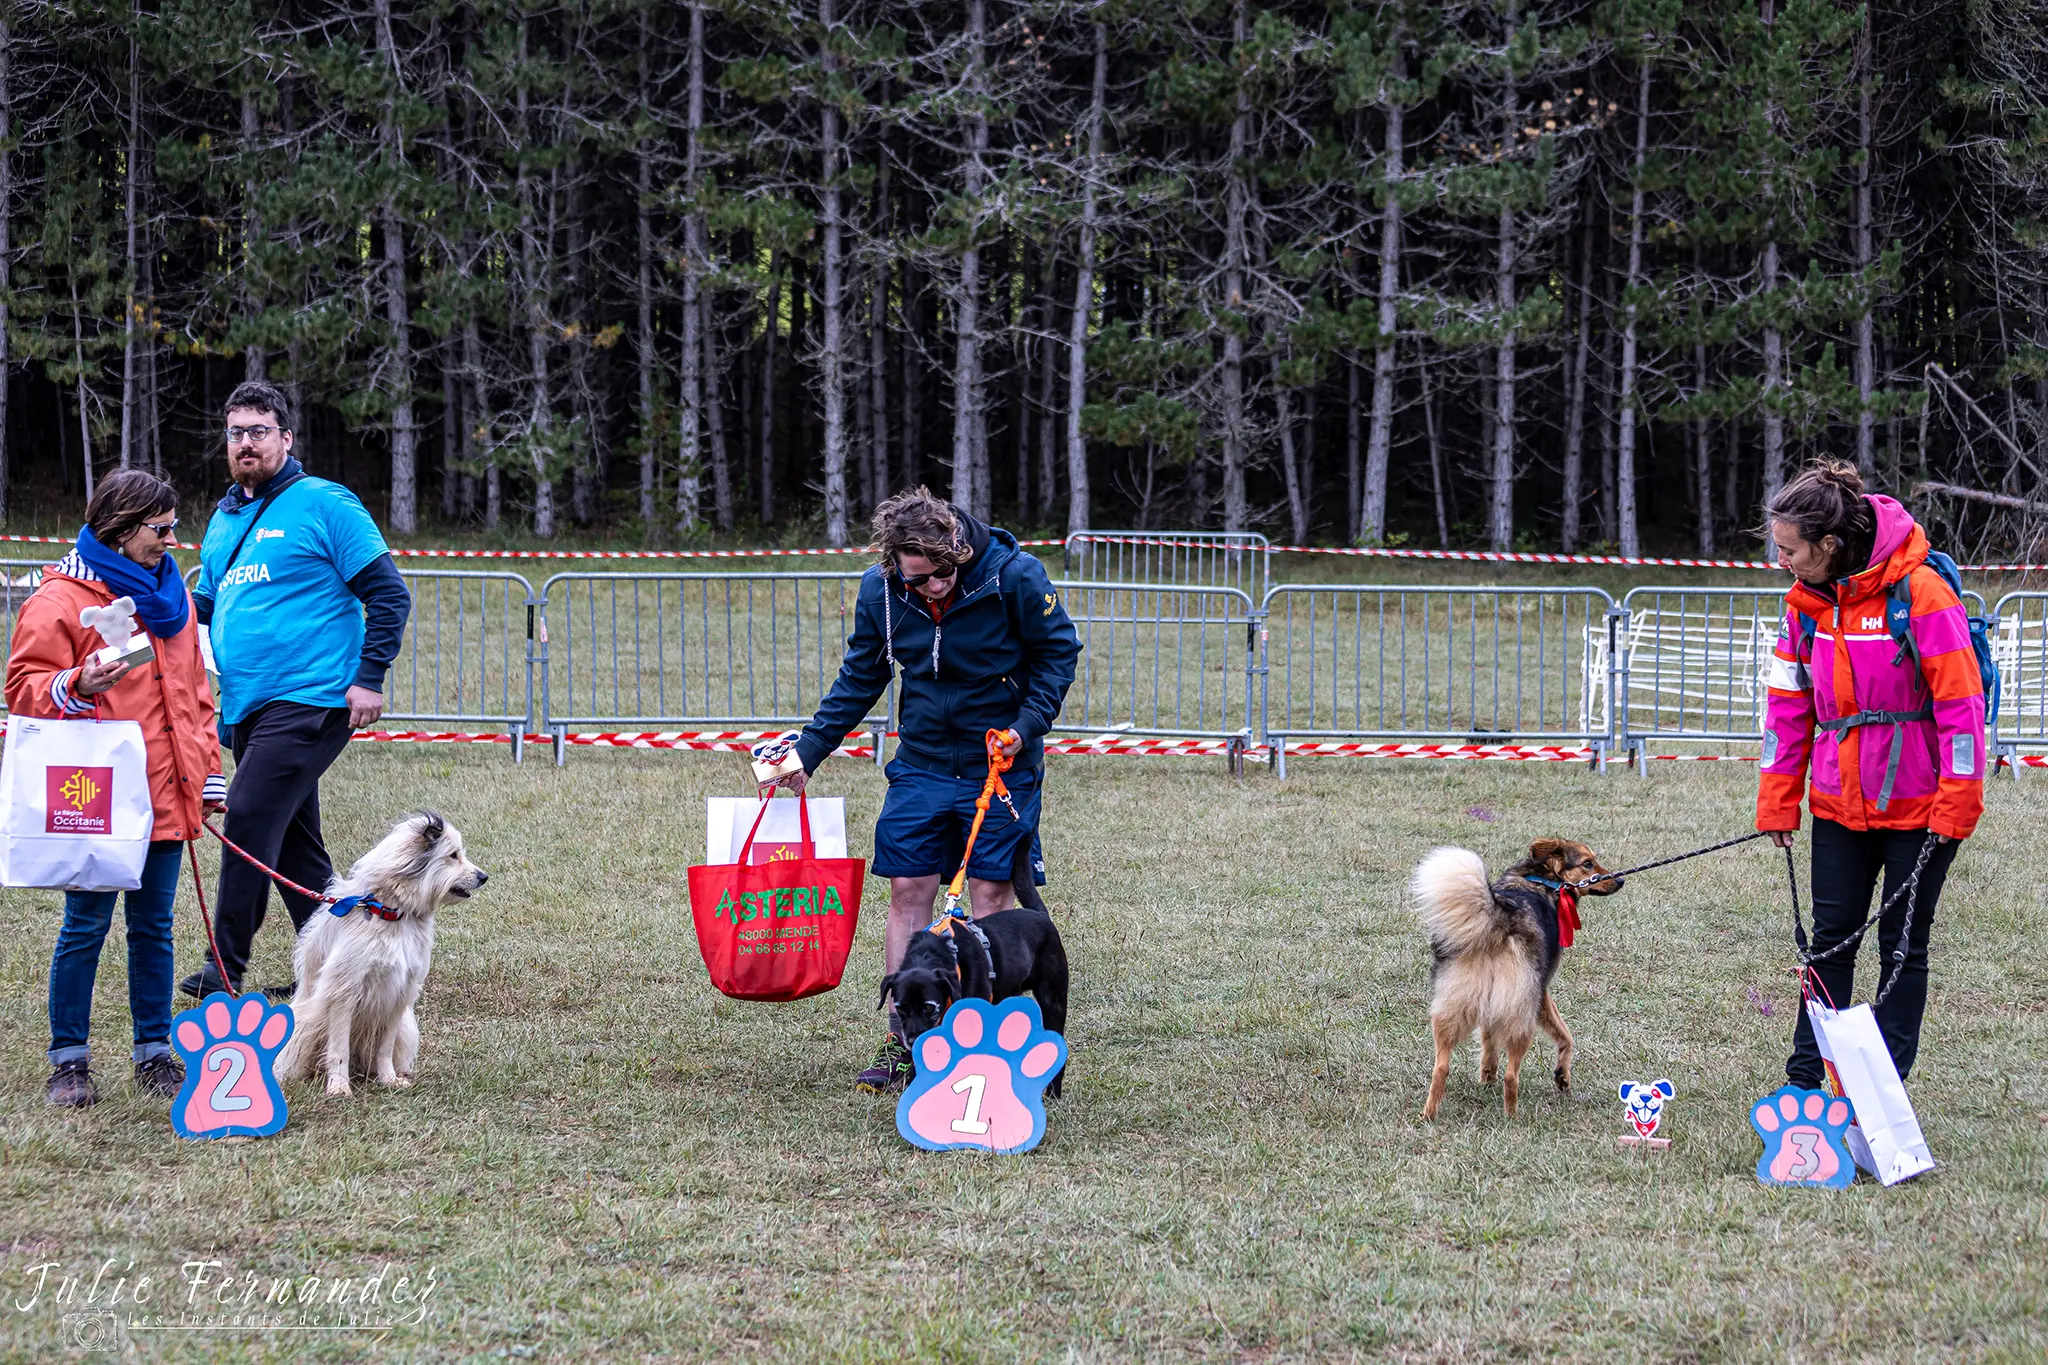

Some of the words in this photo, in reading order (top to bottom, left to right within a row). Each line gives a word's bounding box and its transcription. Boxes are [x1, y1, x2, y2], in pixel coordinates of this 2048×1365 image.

[1861, 616, 1883, 630] HH
[53, 816, 105, 826] Occitanie
[715, 886, 845, 925] ASTERIA
[738, 929, 773, 940] 48000
[776, 925, 819, 939] MENDE
[738, 945, 753, 955] 04
[756, 944, 771, 954] 66
[773, 943, 787, 953] 65
[791, 941, 805, 952] 12
[808, 939, 820, 950] 14
[208, 1047, 252, 1112] 2
[950, 1073, 990, 1135] 1
[1789, 1132, 1820, 1178] 3
